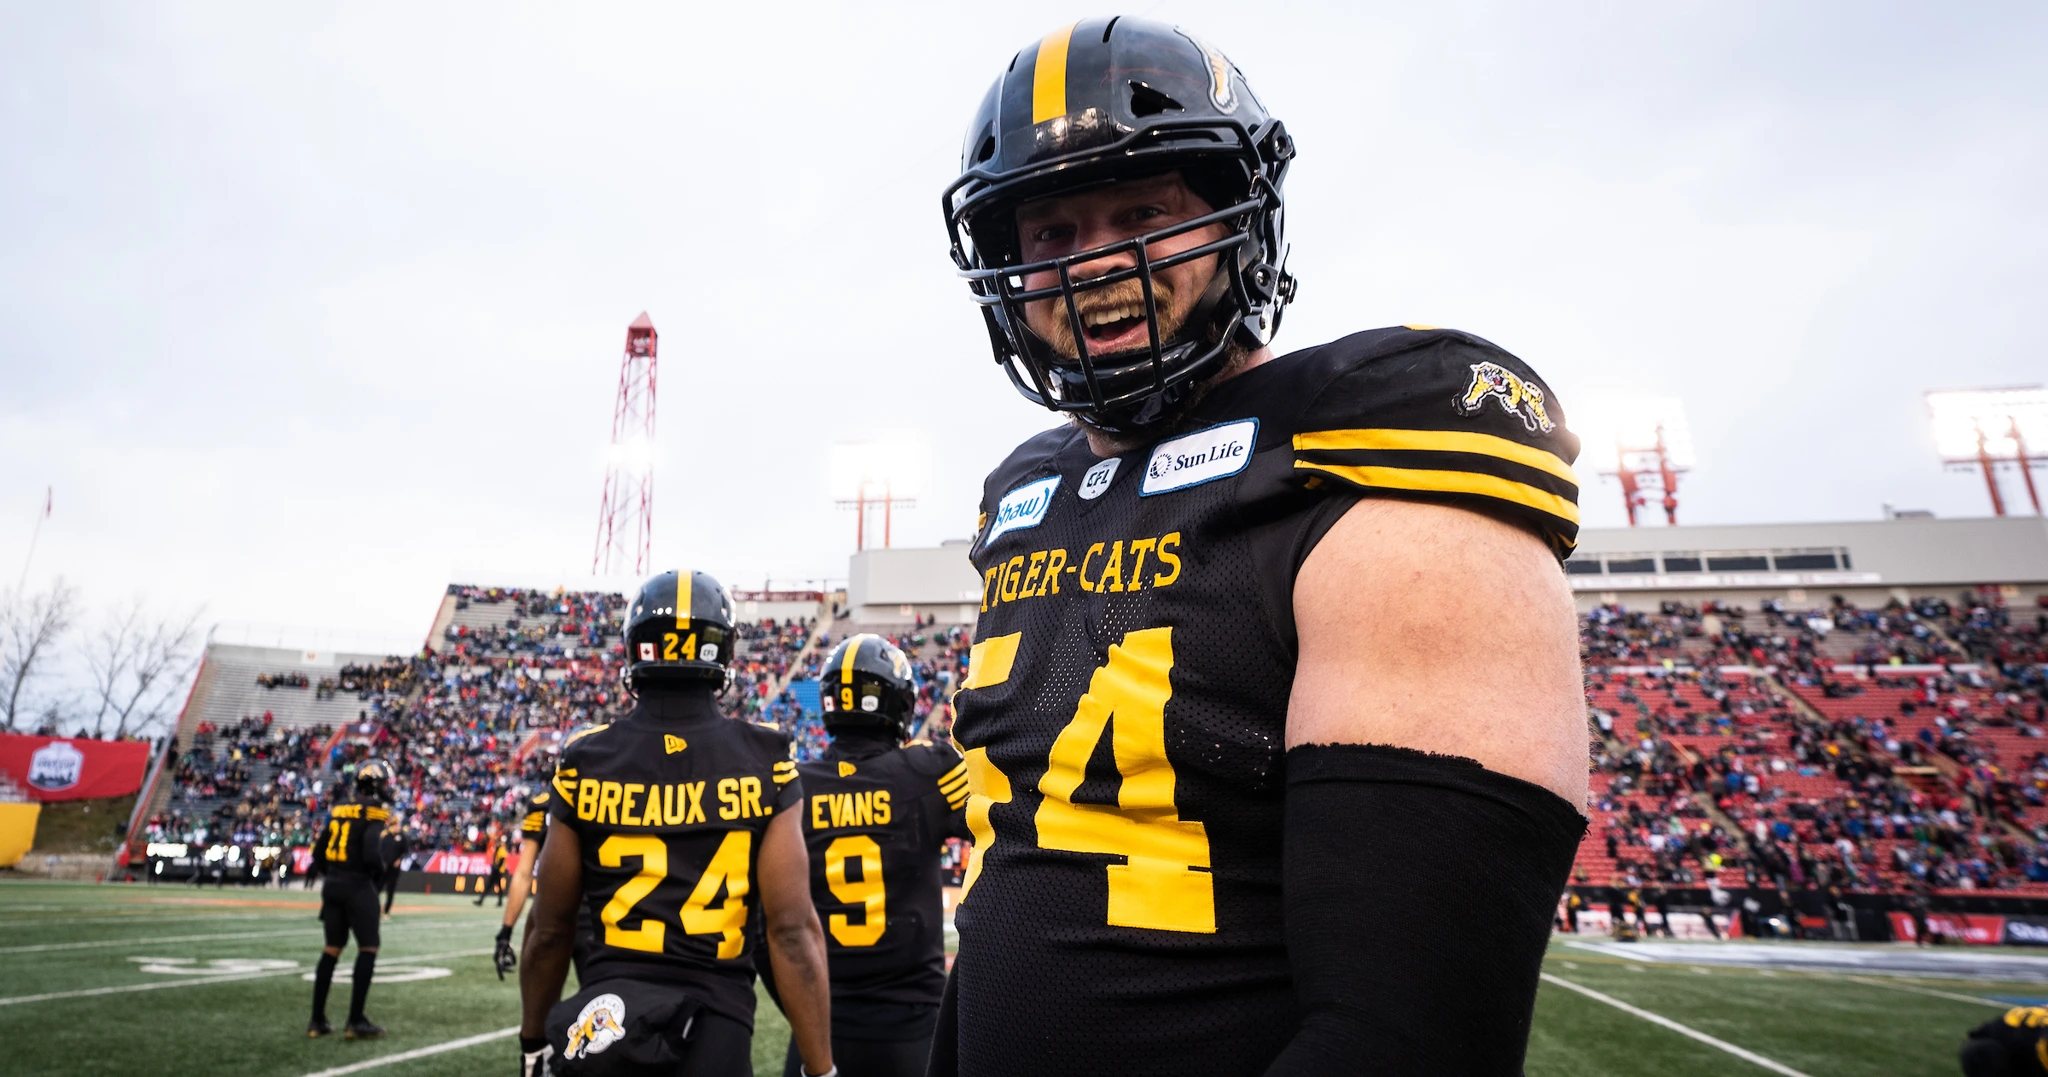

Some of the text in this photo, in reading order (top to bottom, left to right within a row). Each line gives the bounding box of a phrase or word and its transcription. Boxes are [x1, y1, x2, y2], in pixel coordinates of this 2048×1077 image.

[1174, 440, 1244, 471] Sun Life
[1087, 469, 1110, 487] CFL
[980, 532, 1182, 613] TIGER-CATS
[663, 632, 697, 661] 24
[841, 687, 854, 711] 9
[577, 776, 773, 827] BREAUX SR.
[811, 789, 892, 830] EVANS
[325, 819, 351, 861] 21
[439, 854, 470, 875] 107
[597, 830, 752, 960] 24
[824, 835, 887, 947] 9
